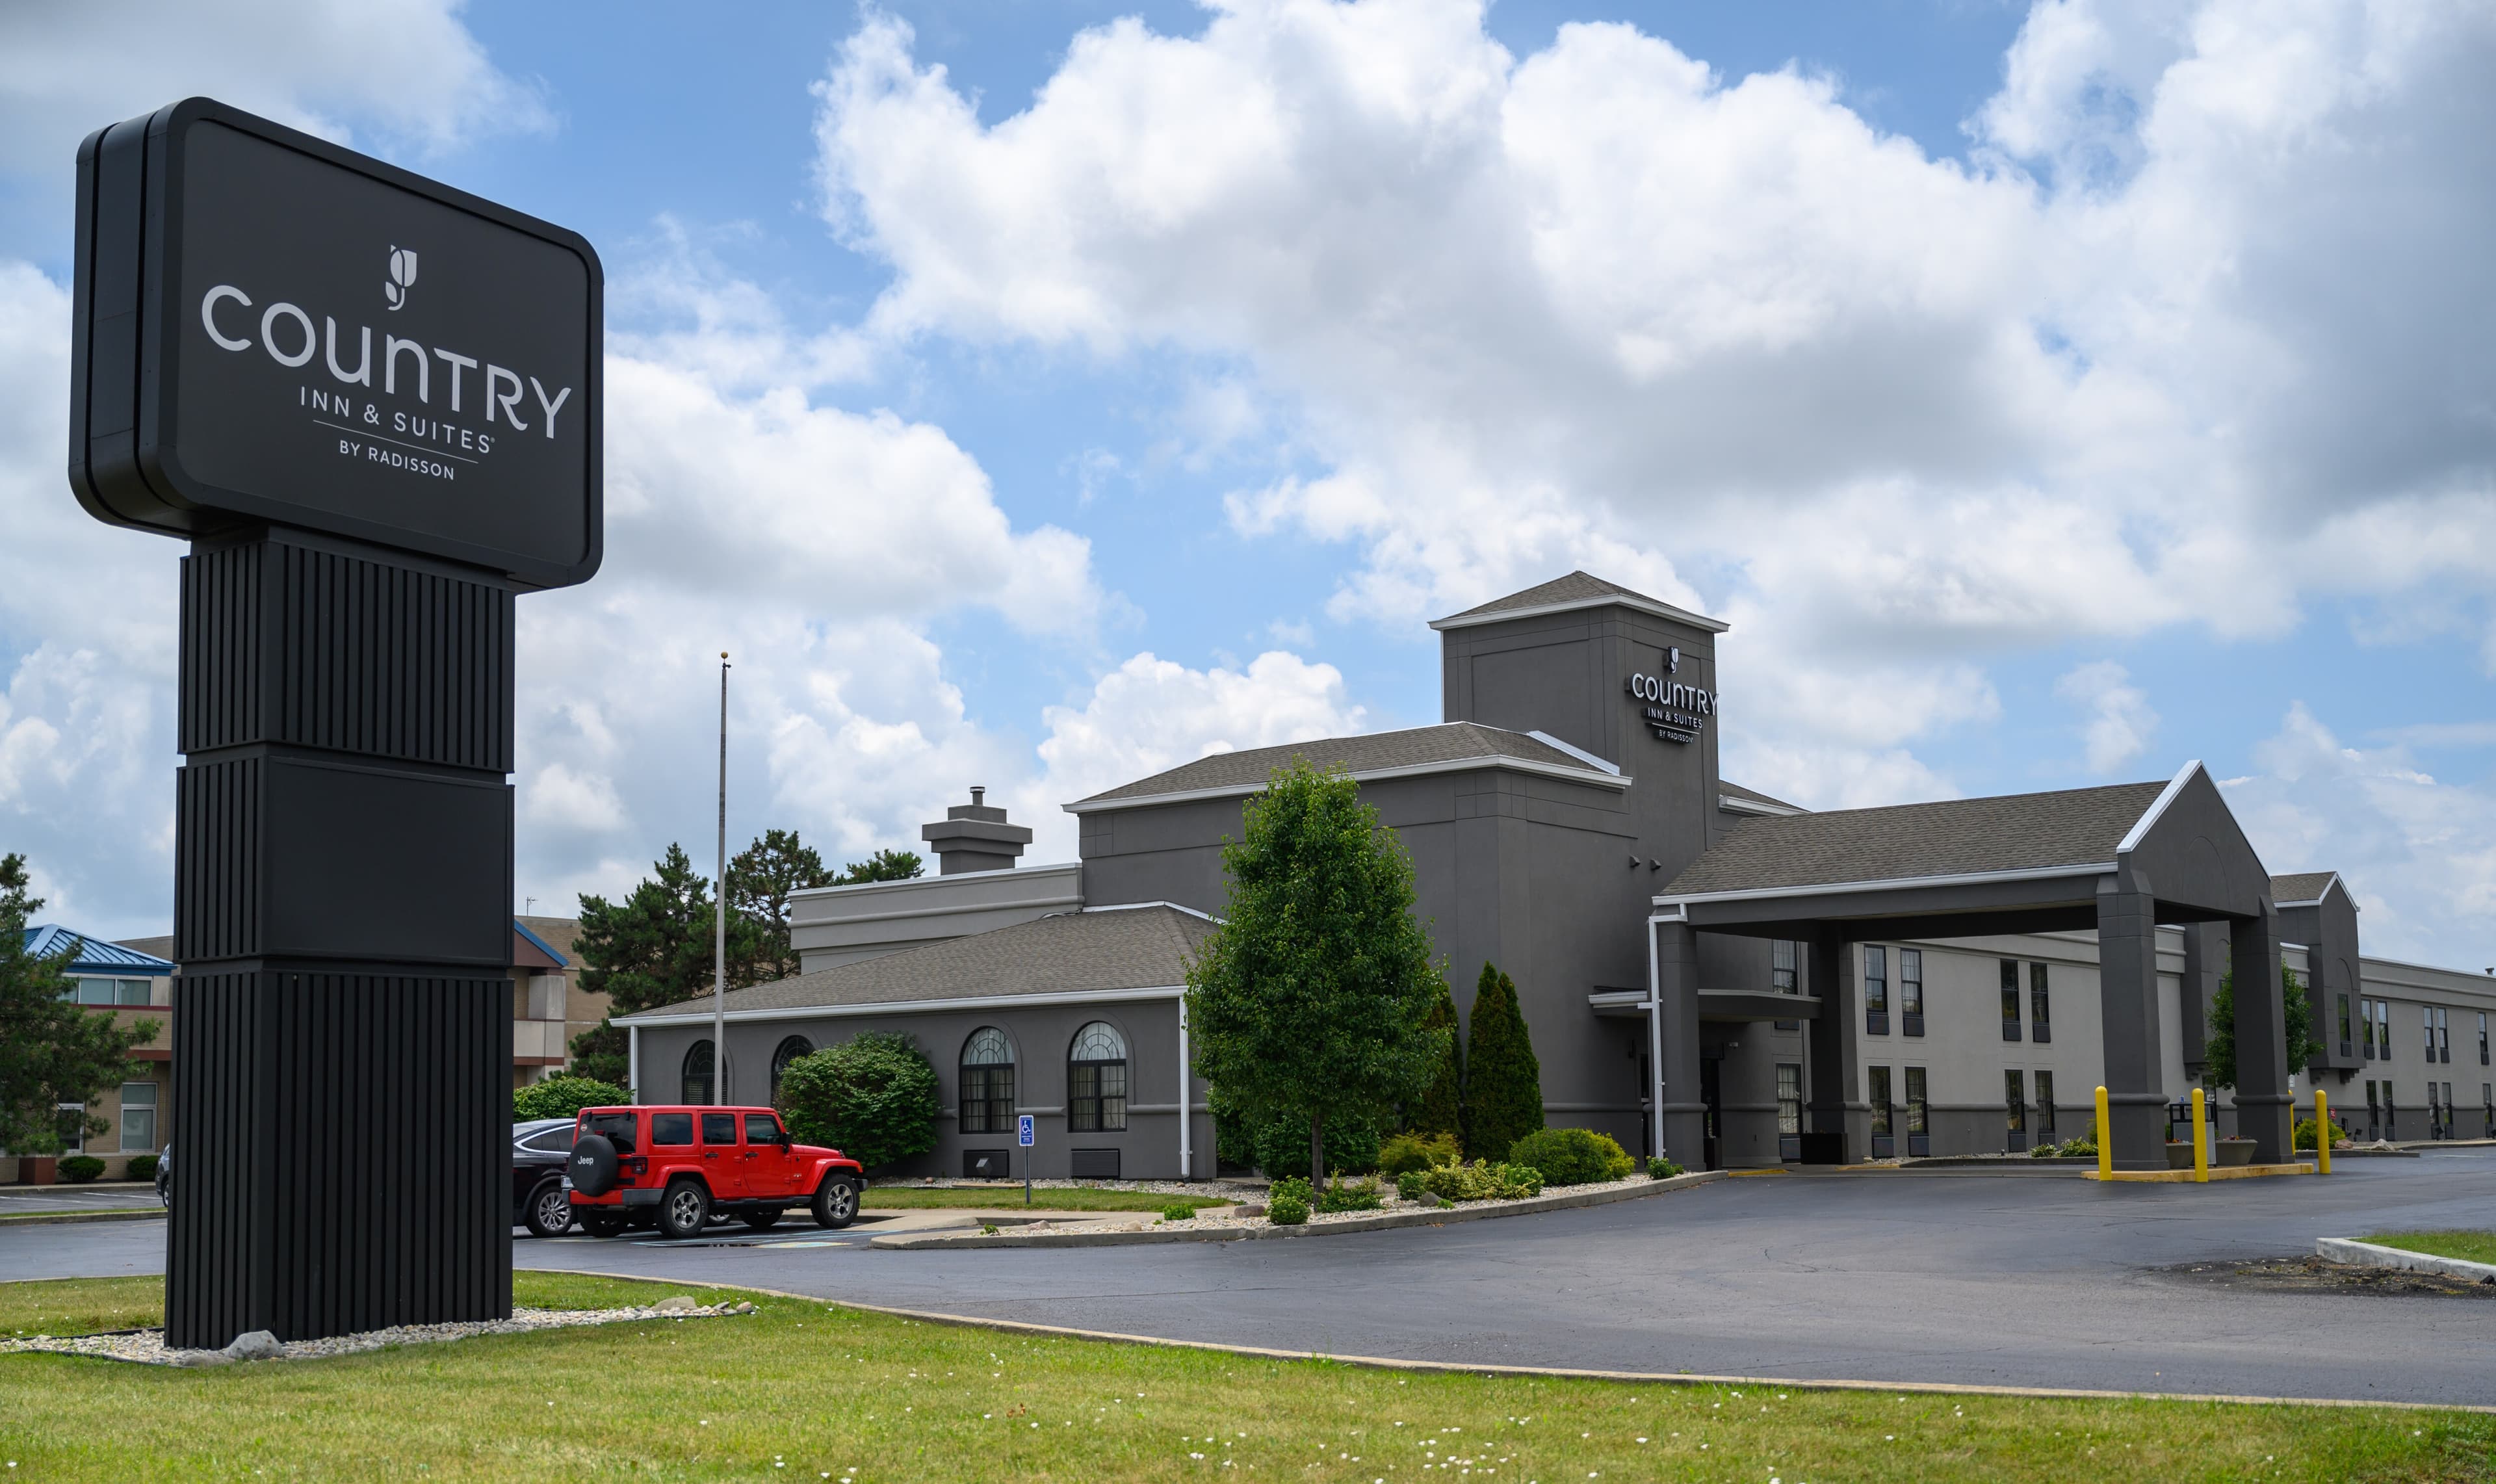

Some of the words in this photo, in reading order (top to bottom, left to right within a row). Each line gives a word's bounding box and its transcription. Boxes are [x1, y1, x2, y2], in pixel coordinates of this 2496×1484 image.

[301, 386, 349, 417] INN
[363, 404, 380, 425] &
[340, 439, 360, 456] BY
[369, 447, 454, 480] RADISSON
[1648, 707, 1663, 720] INN
[1665, 711, 1671, 722] &
[1674, 713, 1702, 729] SUITES
[1667, 731, 1693, 743] RADISSON
[577, 1156, 594, 1166] Jeep
